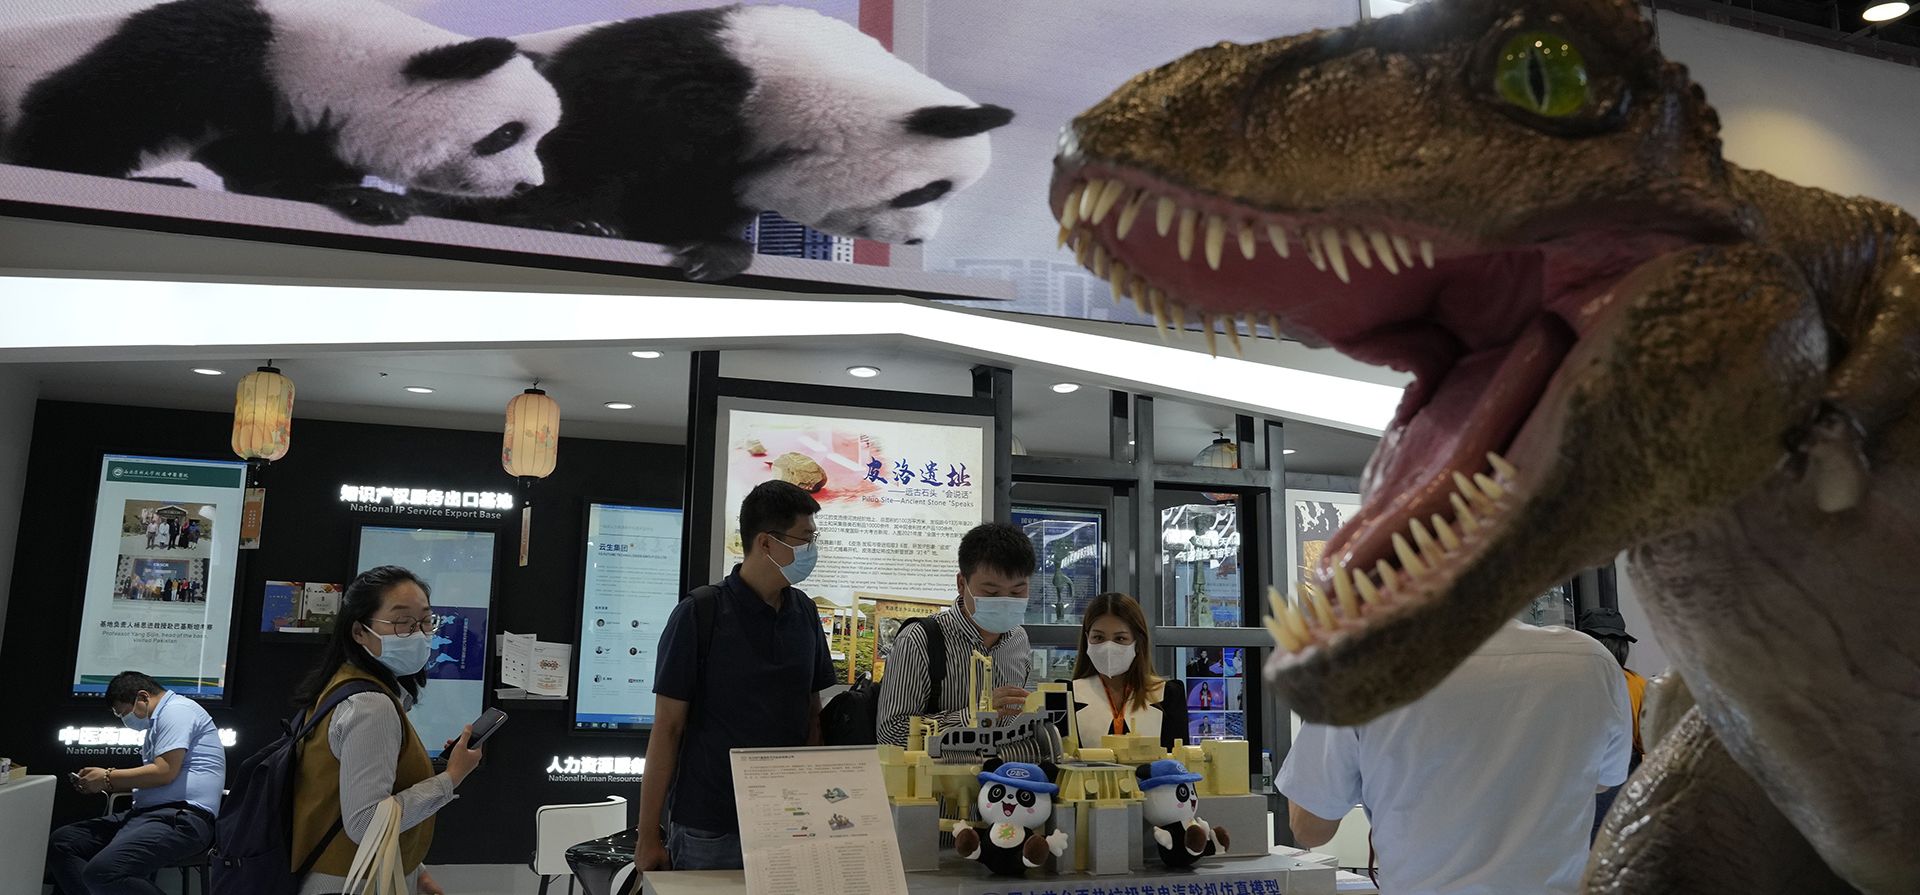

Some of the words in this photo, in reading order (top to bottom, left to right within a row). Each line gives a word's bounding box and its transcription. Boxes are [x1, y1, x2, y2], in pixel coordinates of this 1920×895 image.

[340, 485, 513, 510] 知识产权服务出口基地
[350, 504, 393, 513] National
[407, 507, 442, 516] Service
[445, 509, 478, 519] Export
[480, 511, 502, 519] Base
[599, 543, 629, 552] 云生集团
[66, 747, 108, 755] National
[111, 747, 131, 755] TCM
